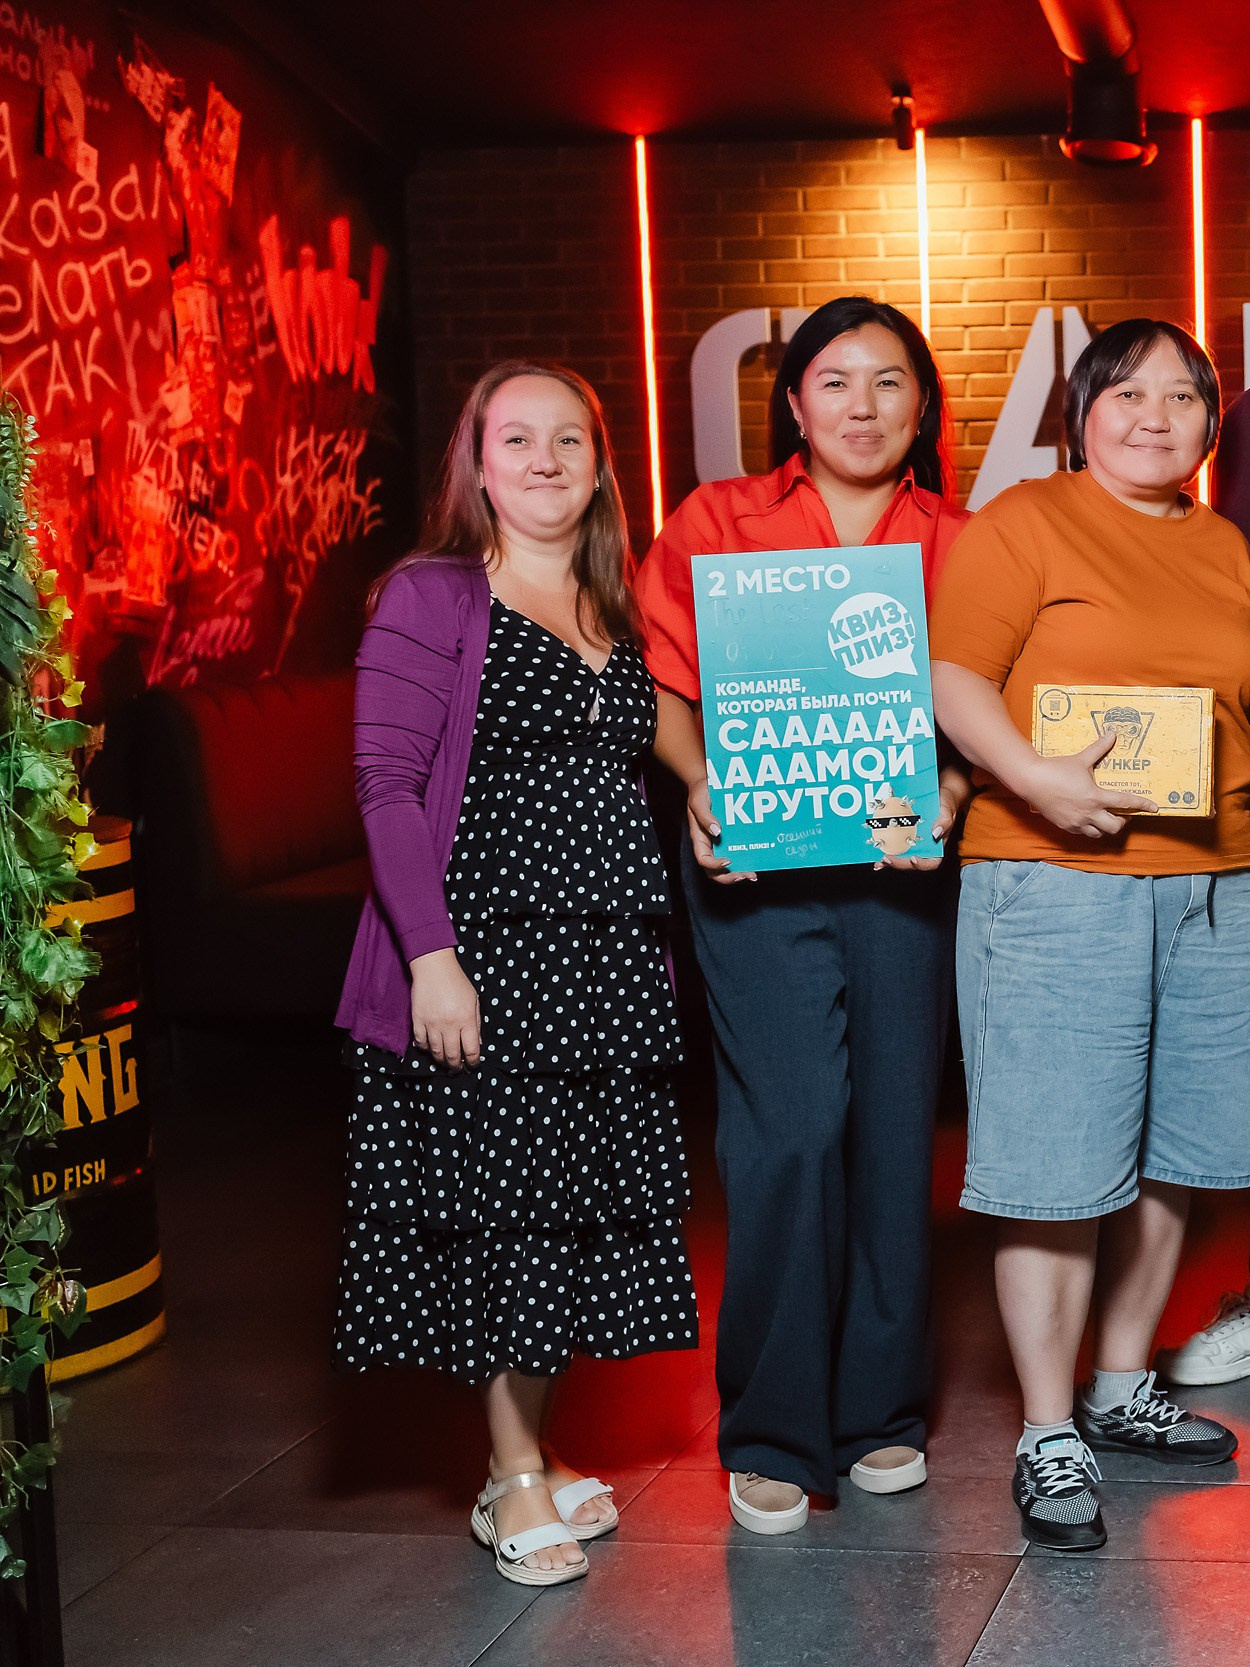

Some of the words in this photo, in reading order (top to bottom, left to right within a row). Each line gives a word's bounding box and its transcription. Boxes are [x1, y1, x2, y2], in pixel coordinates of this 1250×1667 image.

[707, 570, 727, 597] 2
[736, 563, 851, 595] МЕСТО
[829, 601, 913, 645] КВИЗ,
[833, 623, 916, 668] ПЛИЗ!
[715, 677, 807, 697] КОМАНДЕ,
[716, 697, 797, 716] КОТОРАЯ
[801, 693, 851, 711] БЫЛА
[853, 689, 912, 706] ПОЧТИ
[717, 706, 935, 752] САААААА
[64, 1158, 107, 1192] FISH
